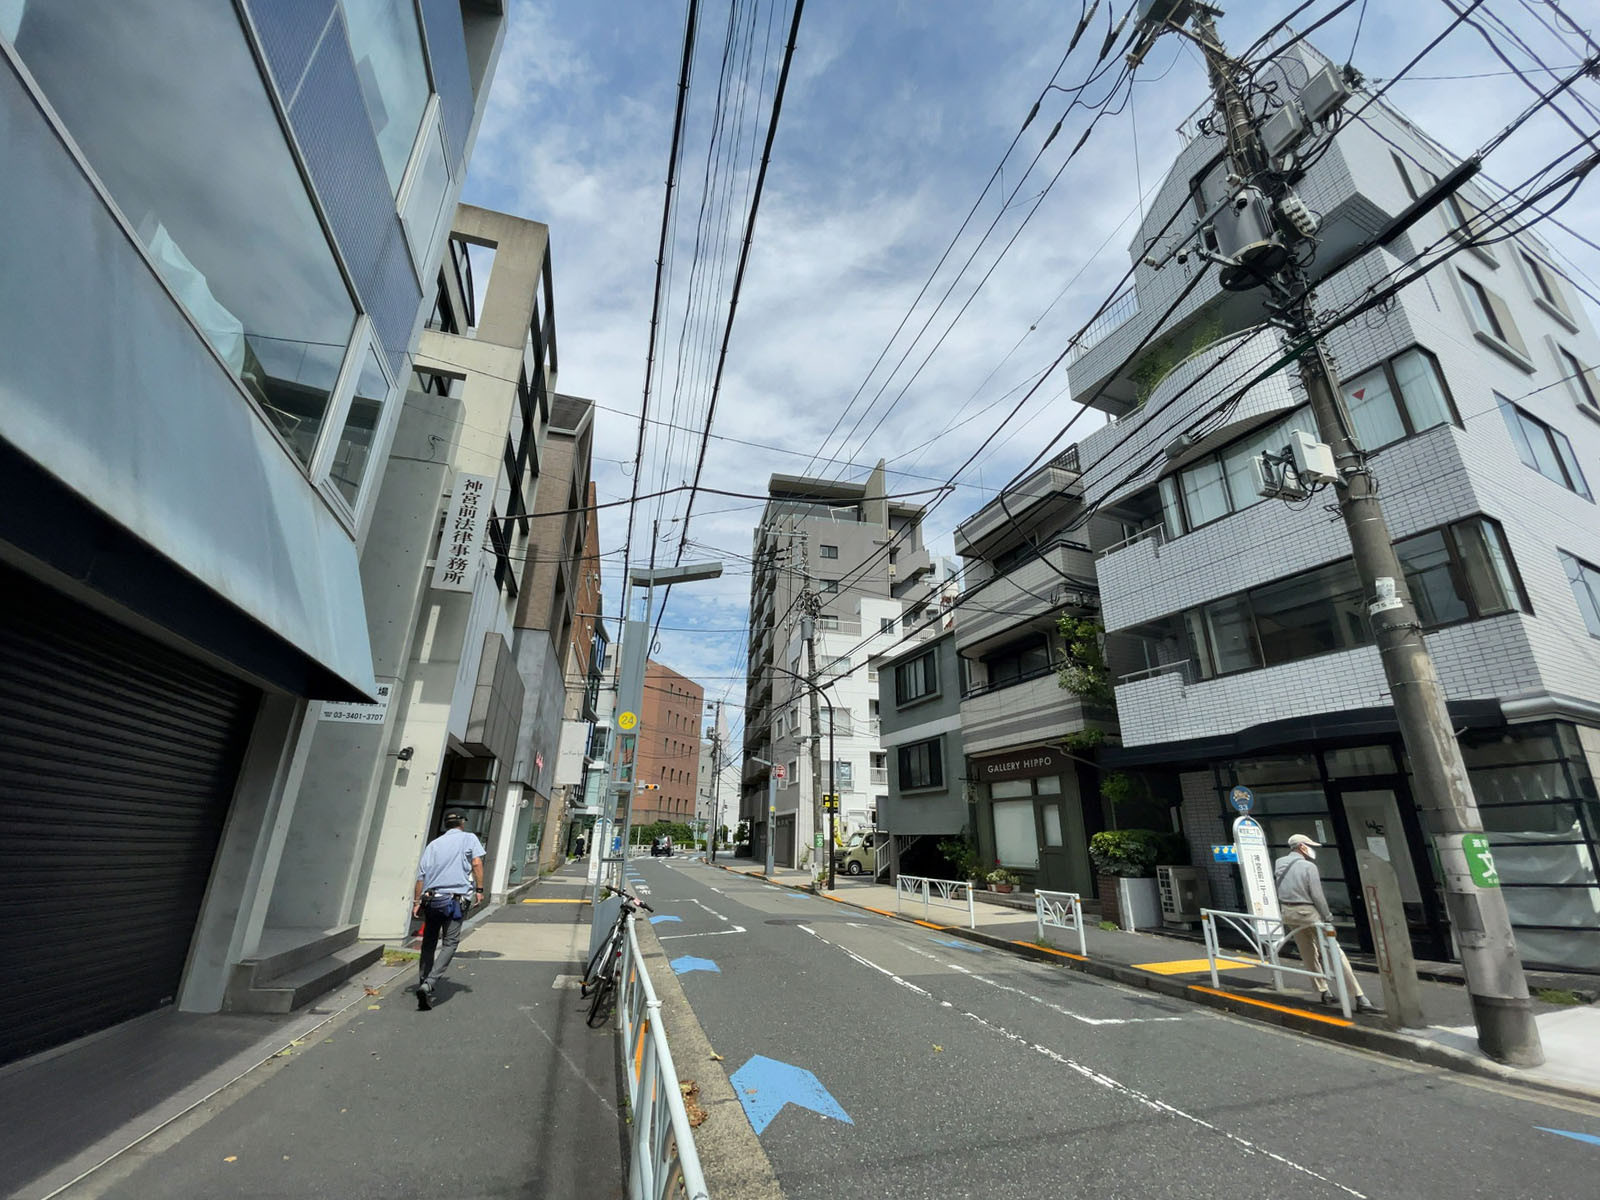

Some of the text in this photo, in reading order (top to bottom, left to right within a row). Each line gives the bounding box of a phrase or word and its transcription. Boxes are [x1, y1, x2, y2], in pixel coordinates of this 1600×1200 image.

[442, 479, 484, 585] 神宮前法律事務所
[333, 711, 384, 721] 03-3401-3707
[621, 715, 634, 725] 24
[987, 756, 1052, 773] GALLERY HIPPO
